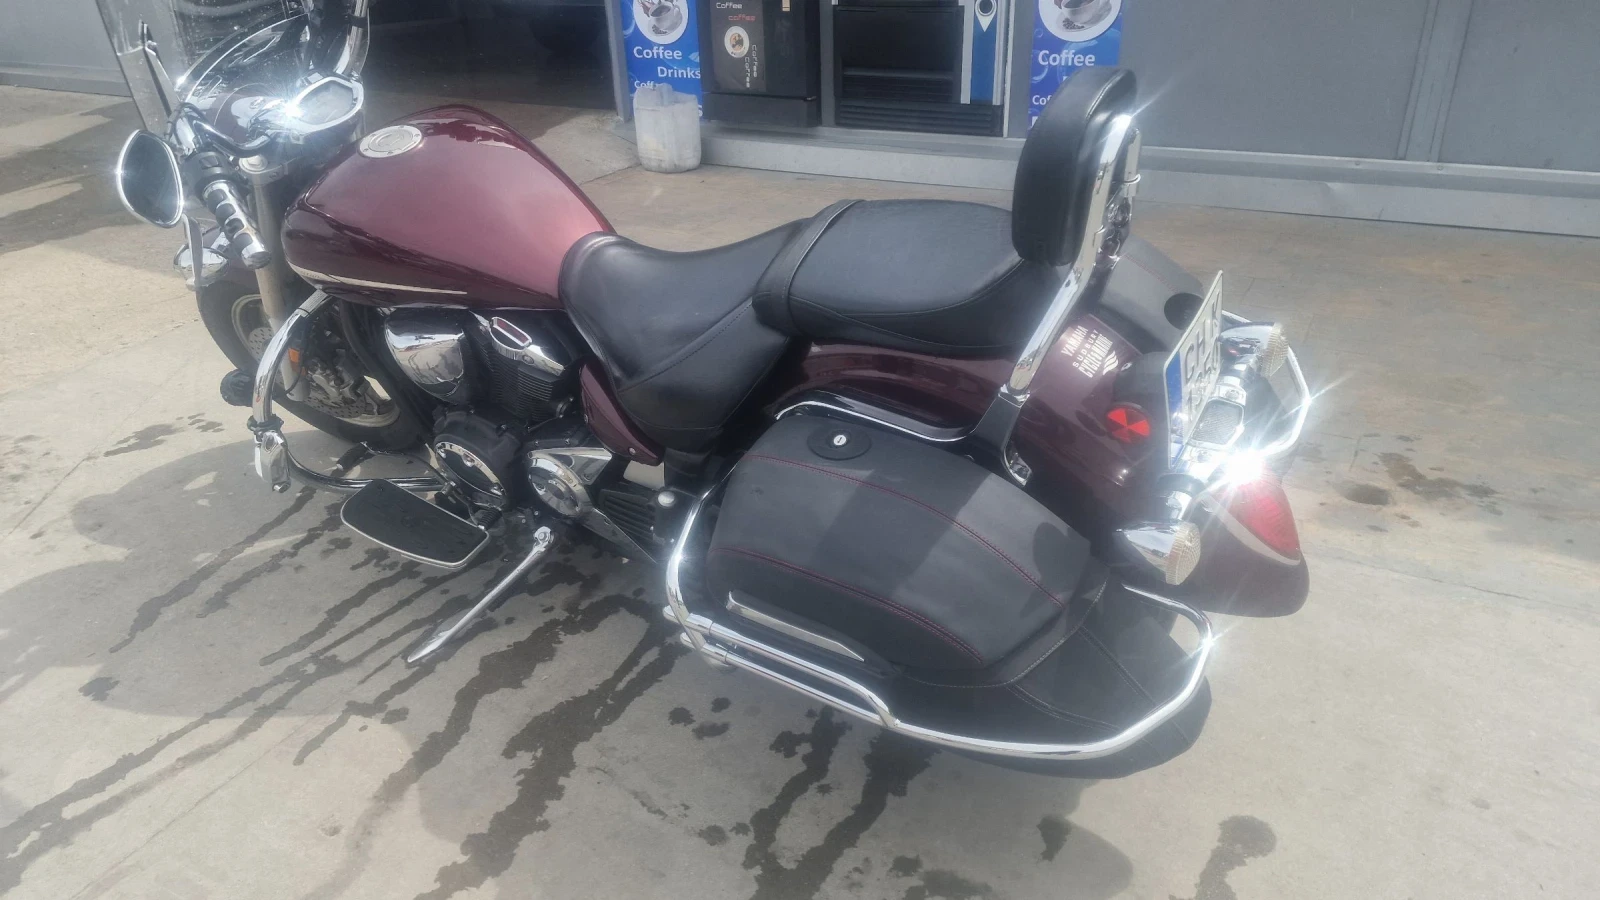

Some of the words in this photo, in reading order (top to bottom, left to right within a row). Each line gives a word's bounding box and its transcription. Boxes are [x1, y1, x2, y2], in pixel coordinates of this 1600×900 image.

[633, 46, 683, 60] Coffee
[1038, 50, 1095, 66] Coffee
[657, 66, 701, 79] Drinks
[634, 80, 656, 89] Coff
[1061, 325, 1089, 356] YAMAHA
[1072, 329, 1099, 368] SUDBURY
